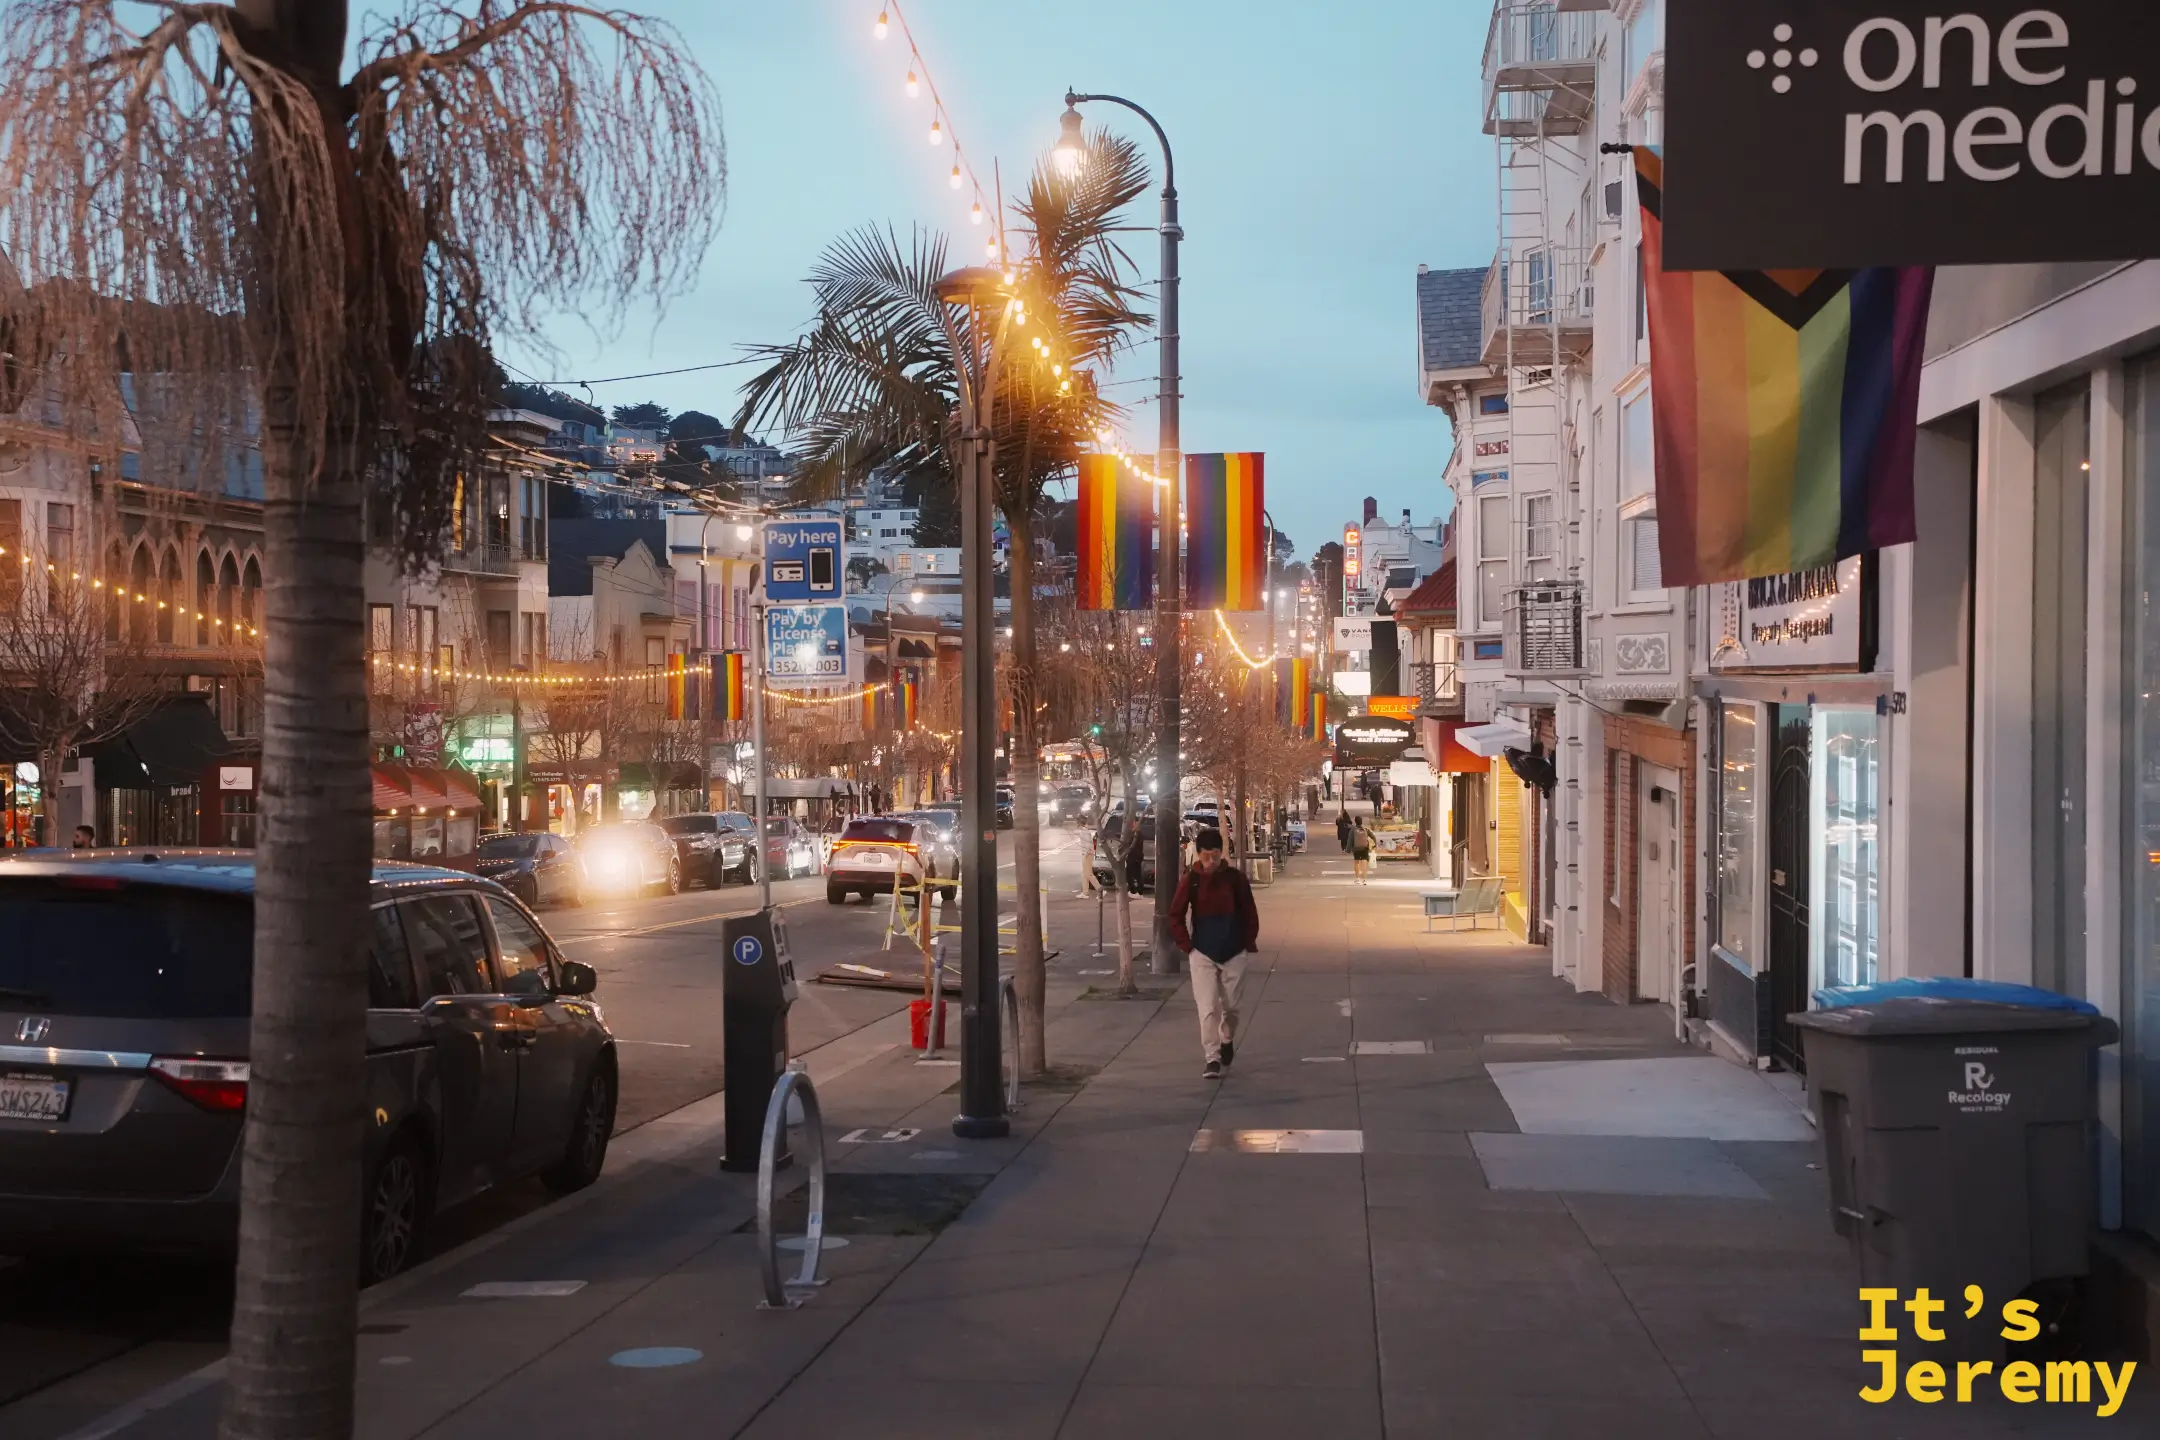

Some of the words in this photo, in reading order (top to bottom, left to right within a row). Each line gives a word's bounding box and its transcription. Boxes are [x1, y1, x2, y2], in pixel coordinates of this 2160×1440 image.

[1843, 9, 2069, 92] one
[768, 530, 798, 548] Pay
[800, 528, 837, 544] here
[1345, 531, 1359, 617] CASTRO
[771, 612, 798, 629] Pay
[803, 610, 823, 627] by
[772, 627, 827, 641] License
[772, 641, 808, 656] Pla
[1369, 704, 1408, 713] WELLS
[171, 784, 192, 797] brand
[742, 941, 755, 960] P
[1948, 1090, 2011, 1105] Recology
